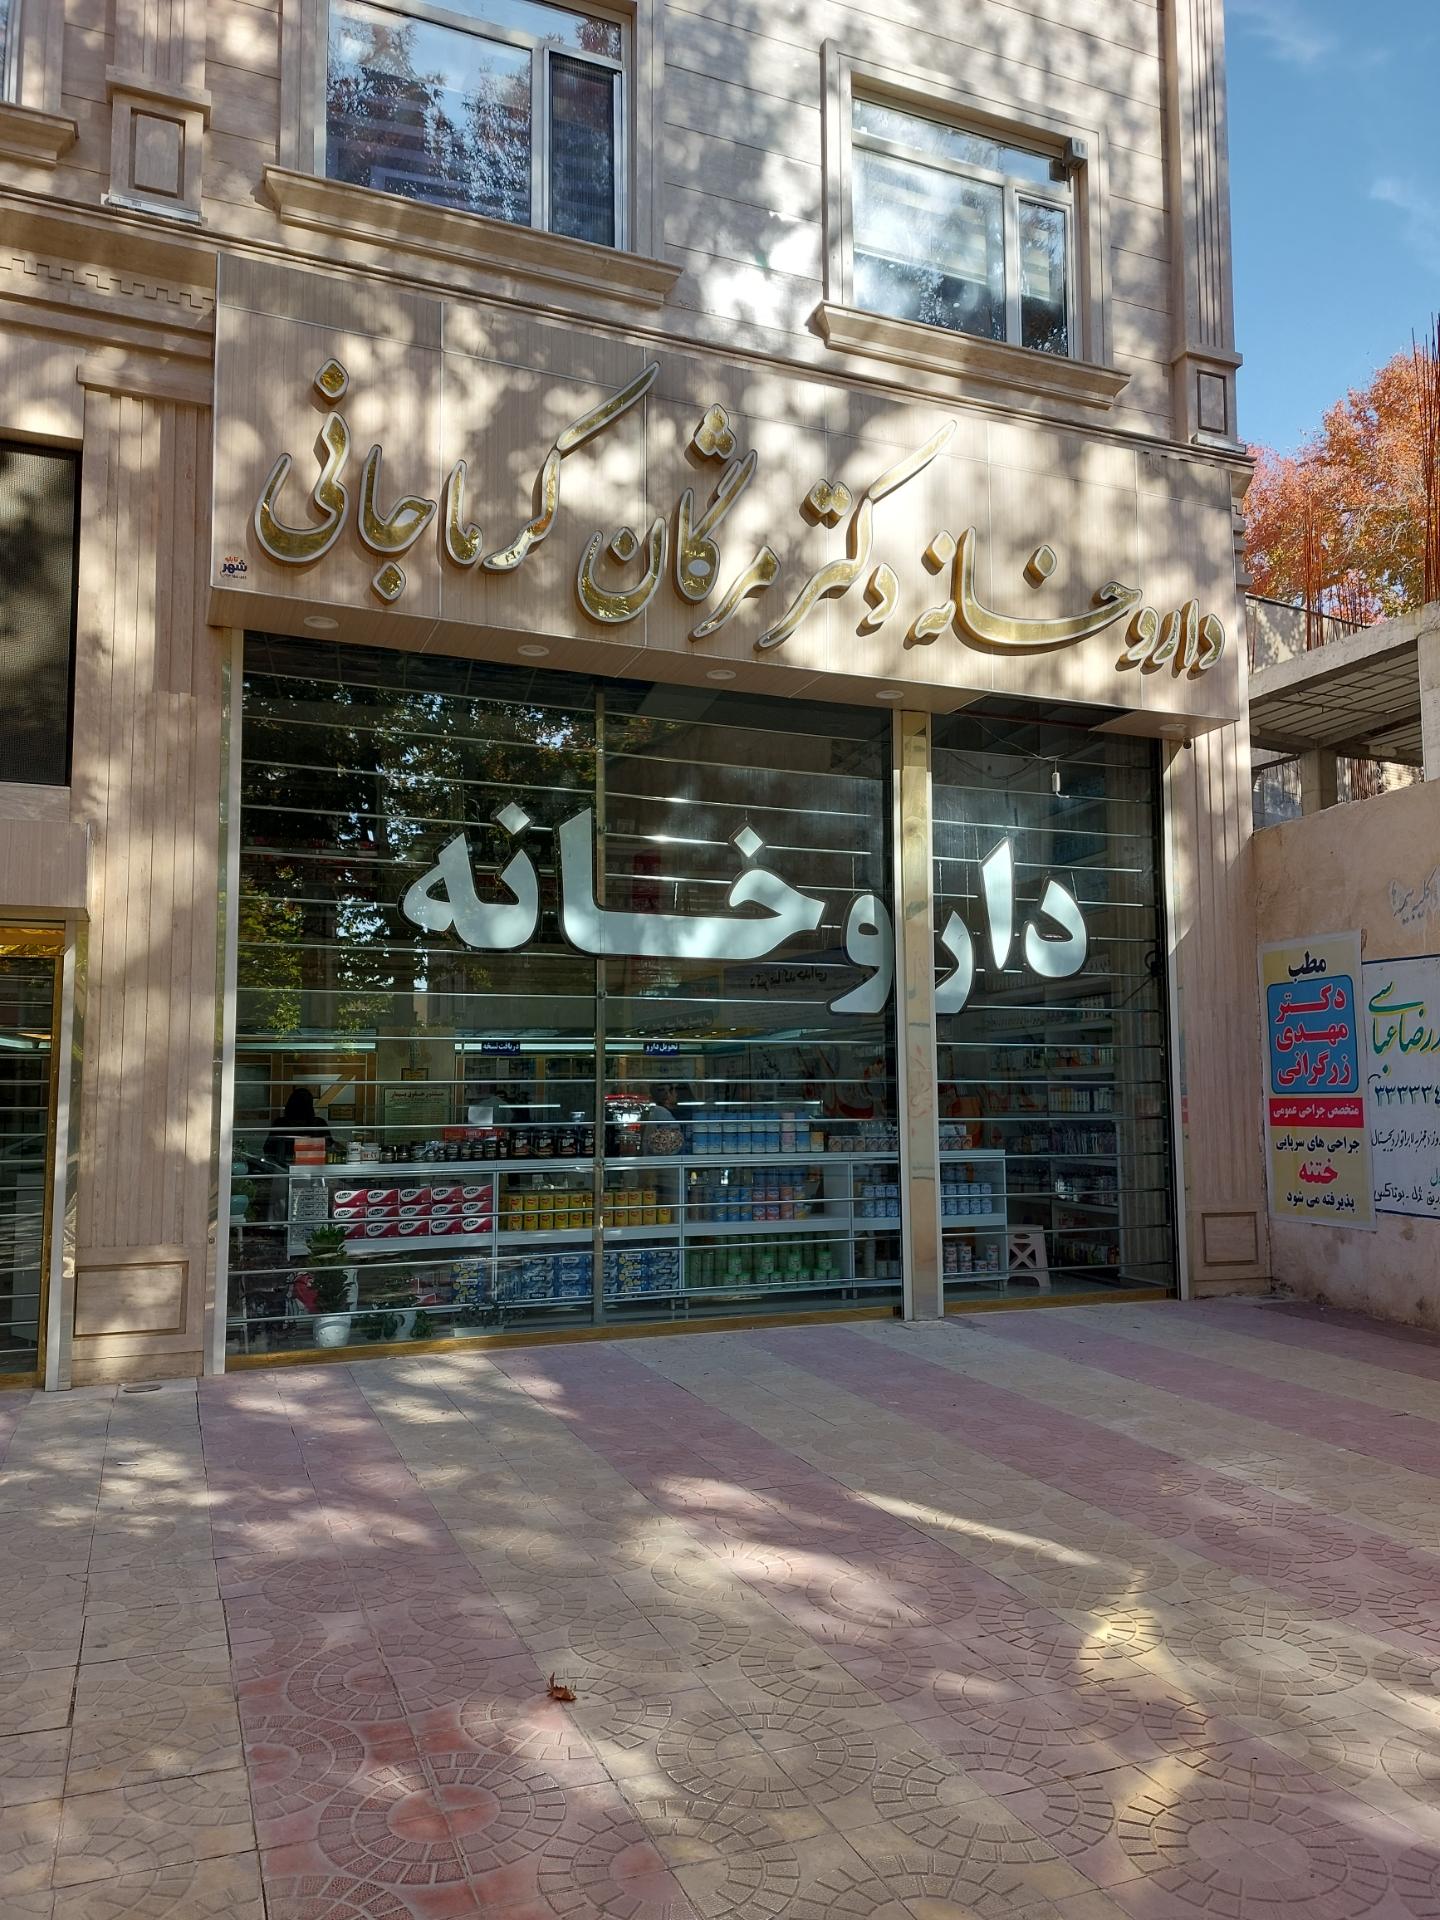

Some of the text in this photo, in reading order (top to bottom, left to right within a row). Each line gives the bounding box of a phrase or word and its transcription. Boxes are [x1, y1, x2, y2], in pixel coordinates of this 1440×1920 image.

[577, 403, 781, 639] مژگان
[758, 419, 958, 648] دکتر
[222, 559, 248, 573] شهر
[402, 801, 1087, 1013] داروخانه
[1288, 950, 1327, 982] مطب
[1275, 984, 1346, 1023] دکتر
[646, 1042, 659, 1052] دارو
[1276, 1022, 1349, 1052] مهدی
[1278, 1048, 1351, 1086] زرگرانی
[1273, 1103, 1359, 1118] متخصص جراحی عمومی
[1276, 1134, 1360, 1154] جراحی های سرپایی
[1299, 1158, 1338, 1184] ختنه
[1287, 1191, 1356, 1213] پذیرفته می شود
[1374, 1183, 1404, 1206] بوتاکس
